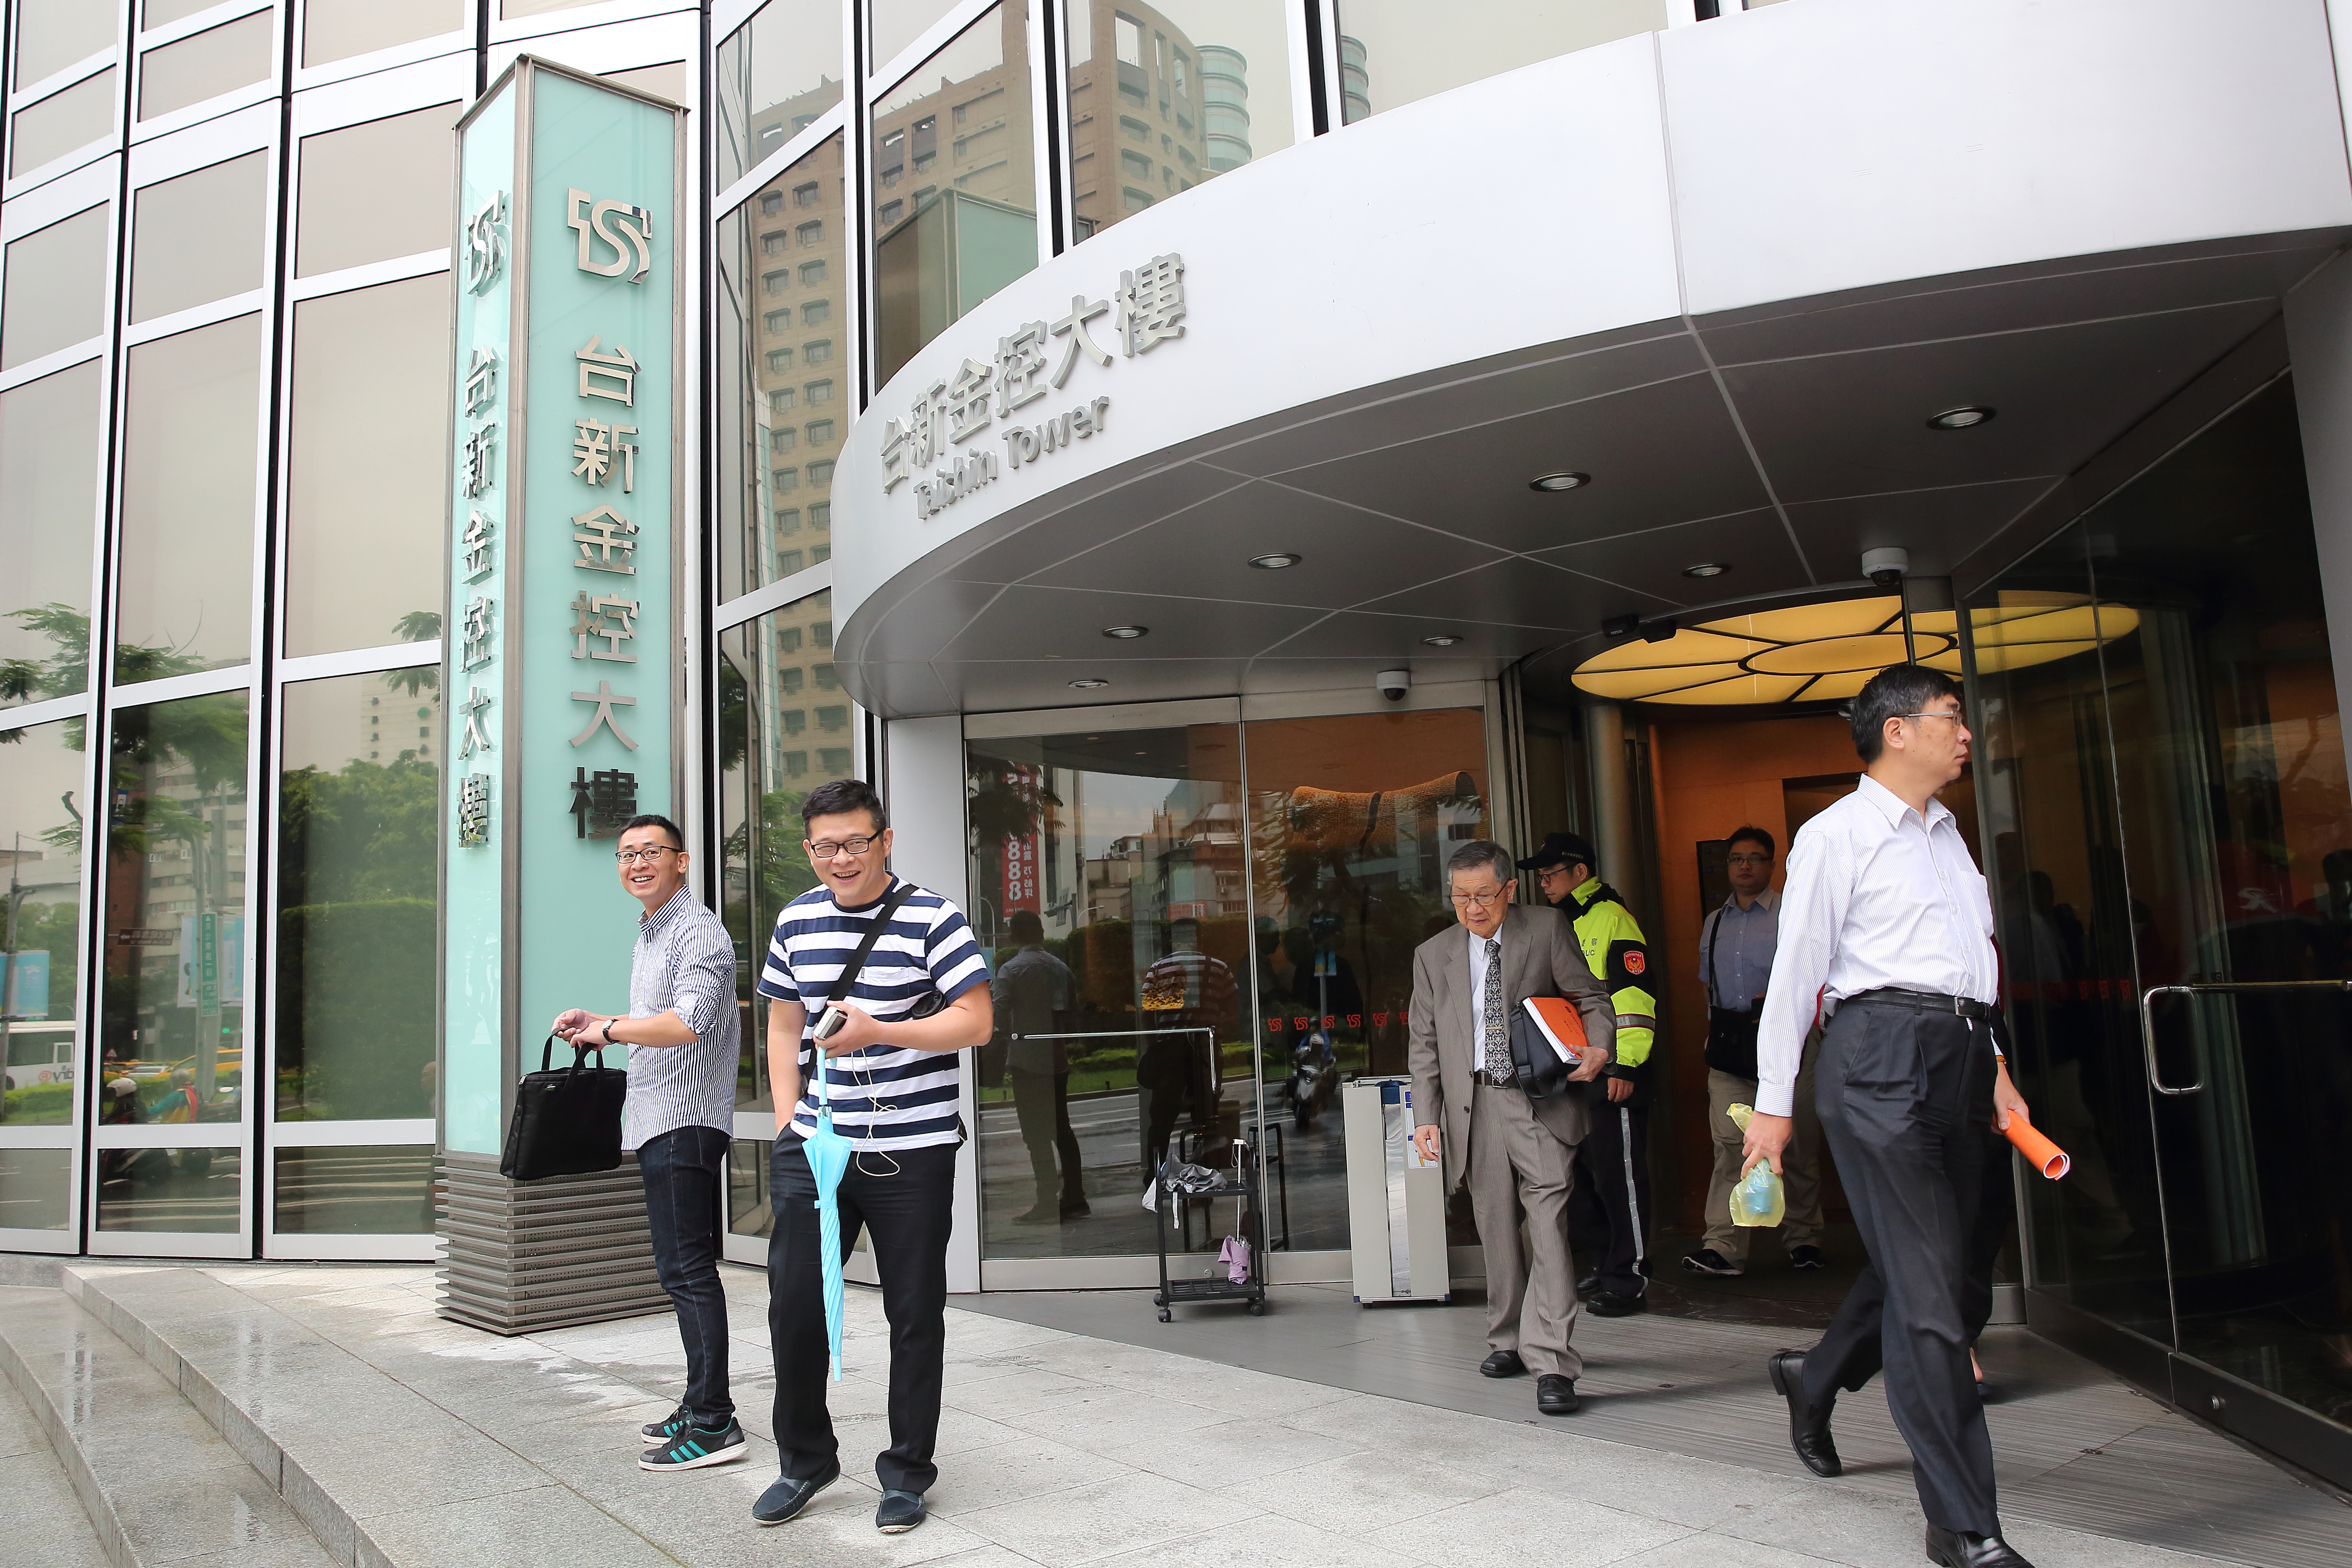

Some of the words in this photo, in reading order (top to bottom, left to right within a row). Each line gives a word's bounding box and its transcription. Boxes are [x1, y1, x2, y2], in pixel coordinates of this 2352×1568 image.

[879, 251, 1186, 494] 台新金控大樓
[913, 448, 997, 520] Taishin
[1001, 395, 1109, 469] Tower
[457, 345, 496, 848] 台新金控大樓
[568, 334, 643, 841] 台新金控大樓
